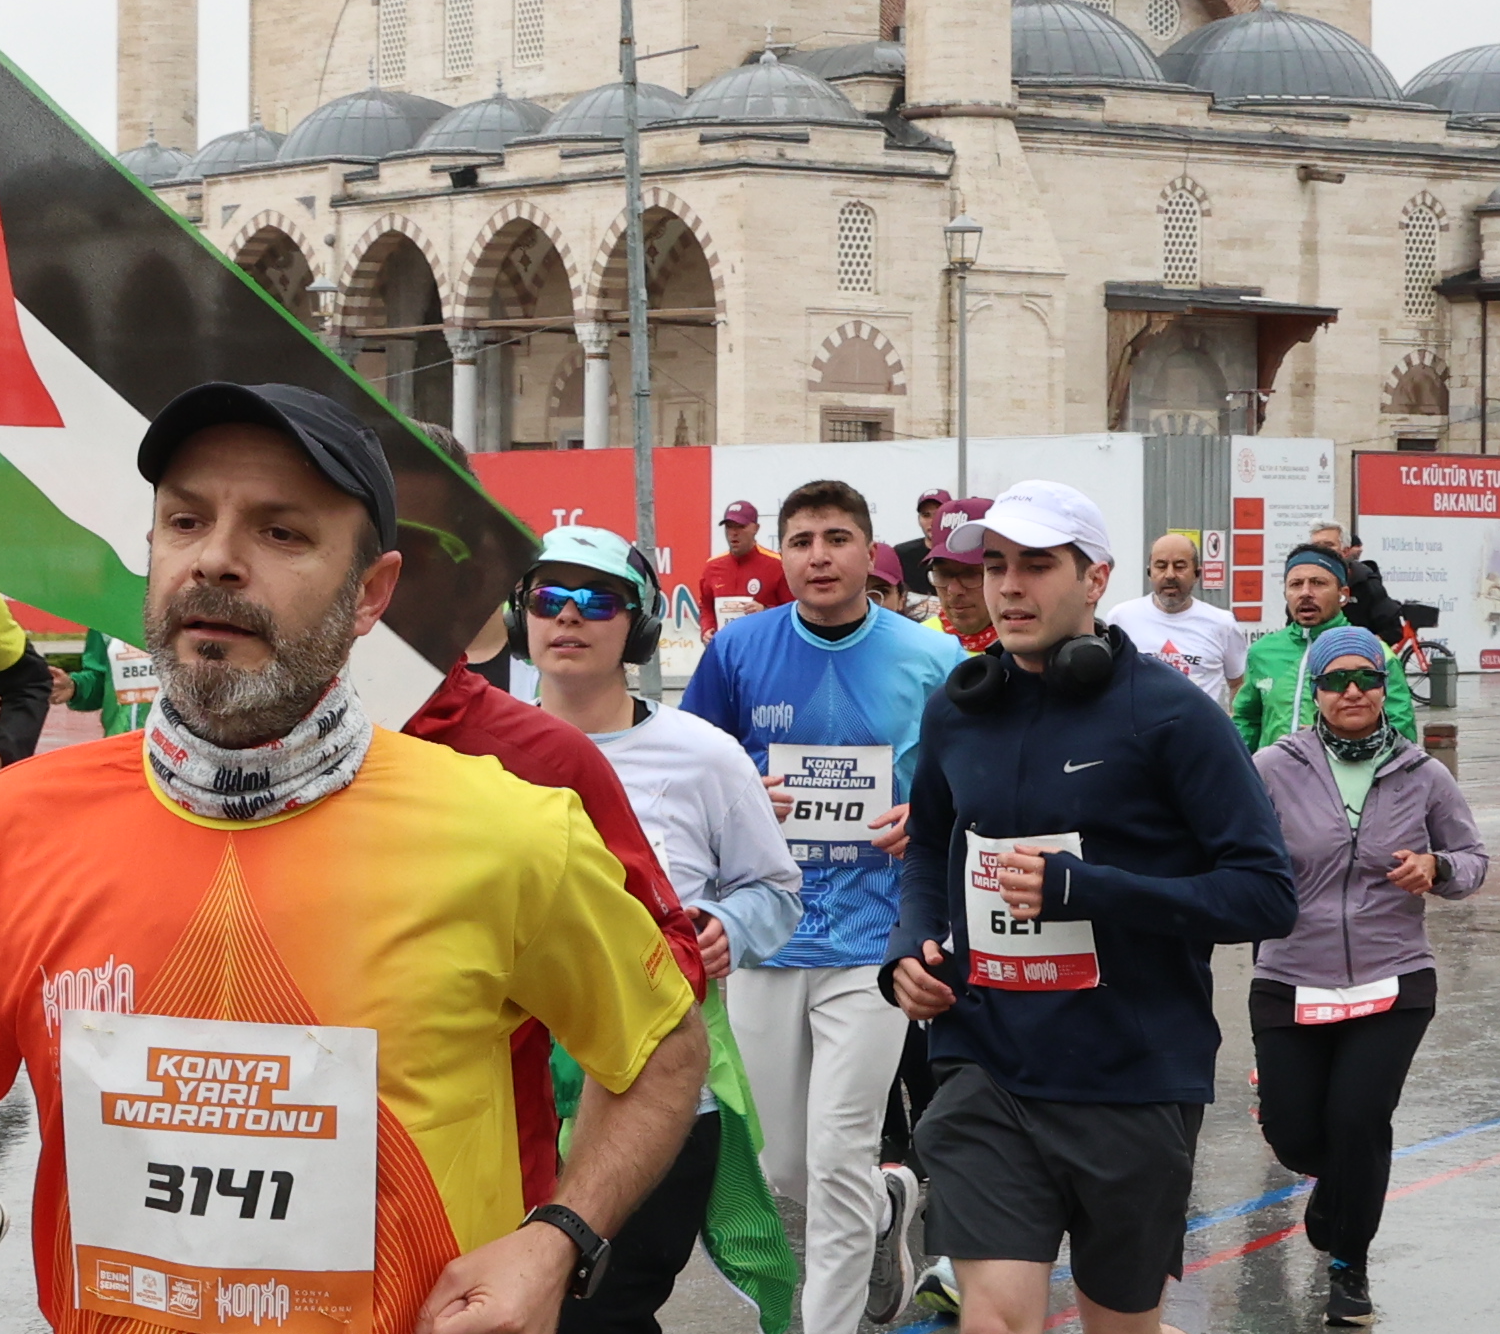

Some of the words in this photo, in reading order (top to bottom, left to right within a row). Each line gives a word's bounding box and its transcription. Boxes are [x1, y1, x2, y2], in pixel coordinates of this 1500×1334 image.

[1400, 466, 1420, 485] T.C.
[1422, 464, 1467, 487] KÜLTÜR
[1469, 470, 1485, 487] VE
[1433, 491, 1497, 513] BAKANLIĞI
[805, 759, 855, 769] KONYA
[813, 769, 847, 778] YARI
[789, 776, 871, 788] MARATONU
[794, 800, 865, 821] 6140
[156, 1054, 280, 1083] KONYA
[175, 1080, 260, 1105] YARI
[114, 1099, 323, 1133] MARATONU
[145, 1161, 294, 1220] 3141
[100, 1270, 129, 1284] BENİM
[294, 1289, 330, 1298] KONYA
